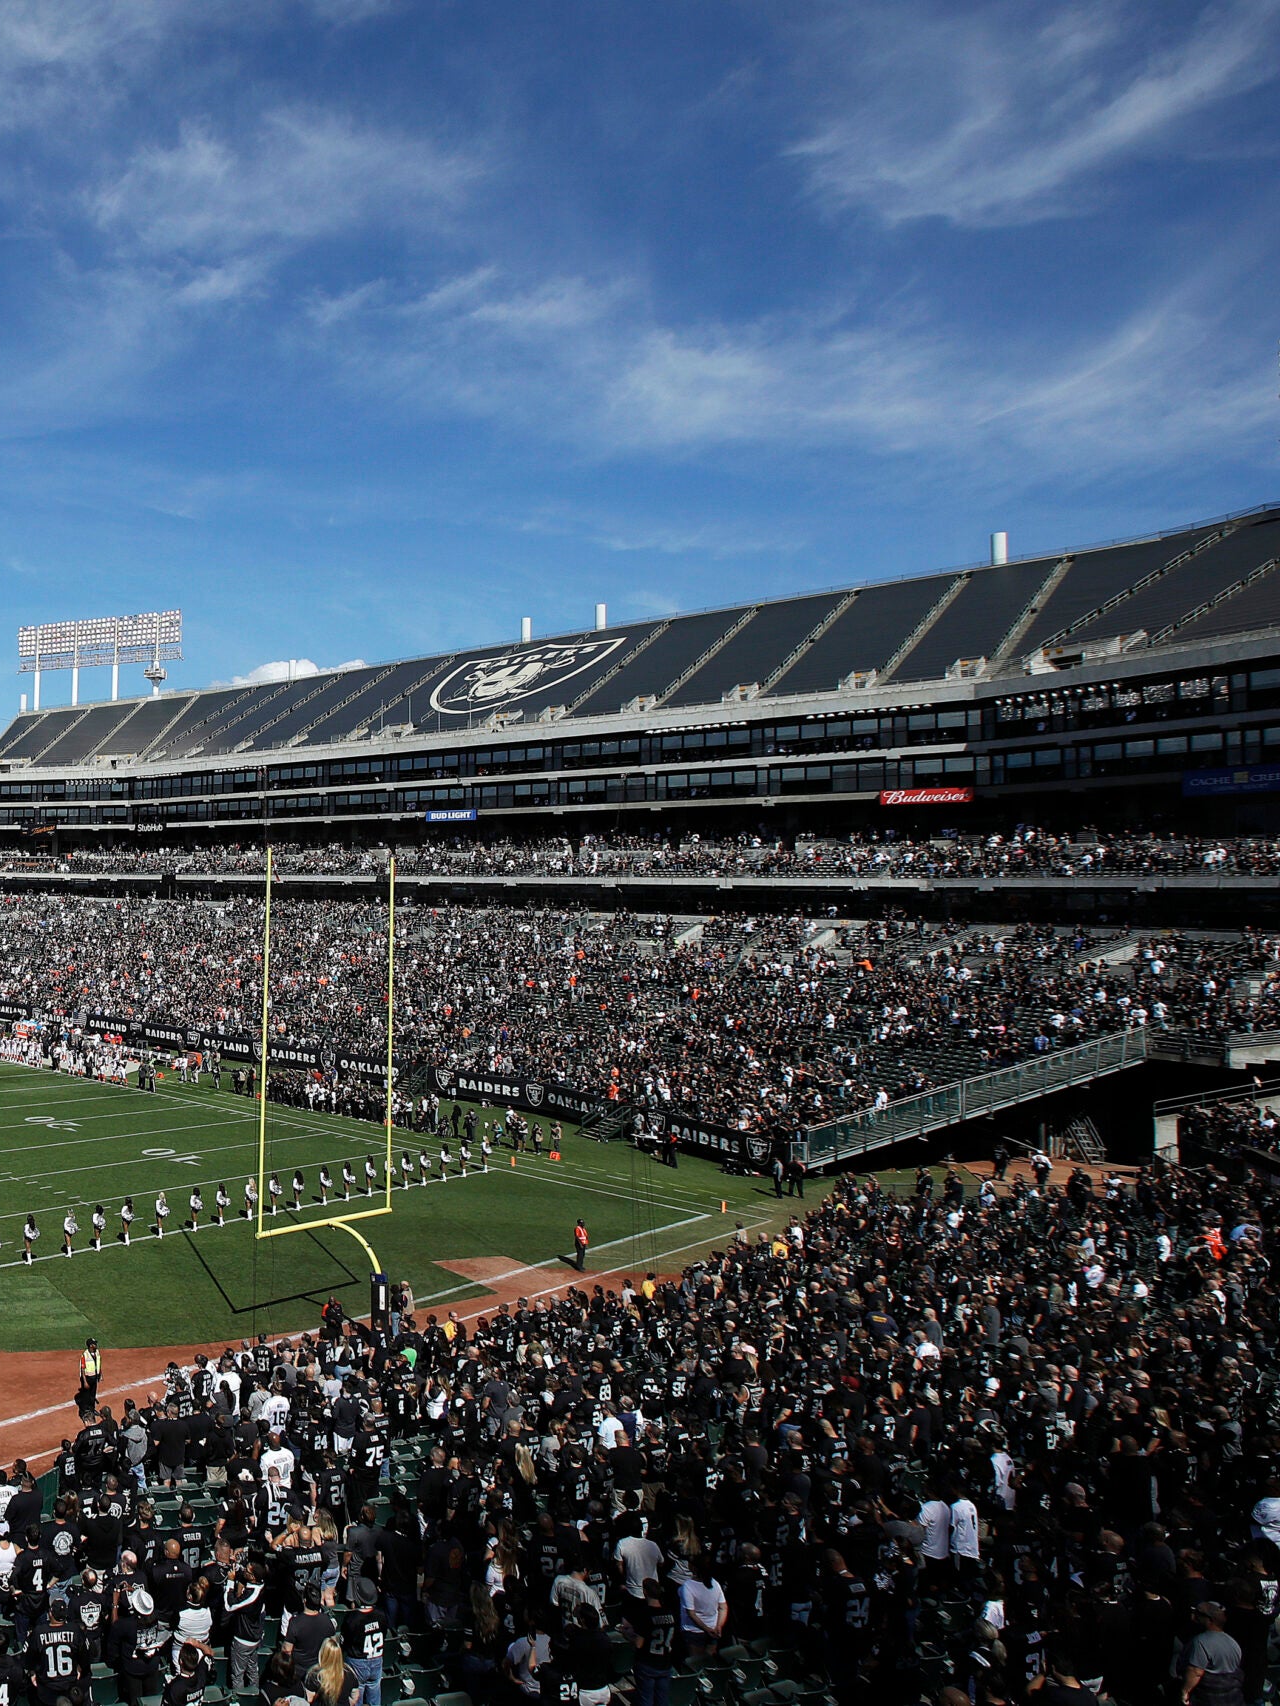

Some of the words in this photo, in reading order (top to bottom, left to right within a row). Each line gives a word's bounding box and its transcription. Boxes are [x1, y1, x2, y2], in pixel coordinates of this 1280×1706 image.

[883, 791, 969, 804] Budweiser
[431, 812, 447, 820] BUD
[448, 811, 472, 819] LIGHT
[137, 823, 163, 832] StubHub
[89, 1020, 127, 1033] OAKLAND
[145, 1028, 182, 1041] RAIDERS
[271, 1048, 316, 1064] RAIDERS
[340, 1059, 399, 1077] OAKLAND
[458, 1078, 520, 1097] RAIDERS
[671, 1124, 740, 1154] RAIDERS
[314, 1434, 328, 1449] 24
[365, 1445, 384, 1467] 75
[576, 1481, 589, 1500] 24
[33, 1558, 43, 1567] CARR
[181, 1547, 200, 1569] 12
[295, 1553, 322, 1563] JACKSON
[32, 1568, 43, 1591] 4
[364, 1621, 379, 1633] JOSEPH
[40, 1631, 74, 1644] PLUNKETT
[363, 1632, 384, 1659] 42
[45, 1644, 73, 1677] 16
[560, 1682, 578, 1700] 24
